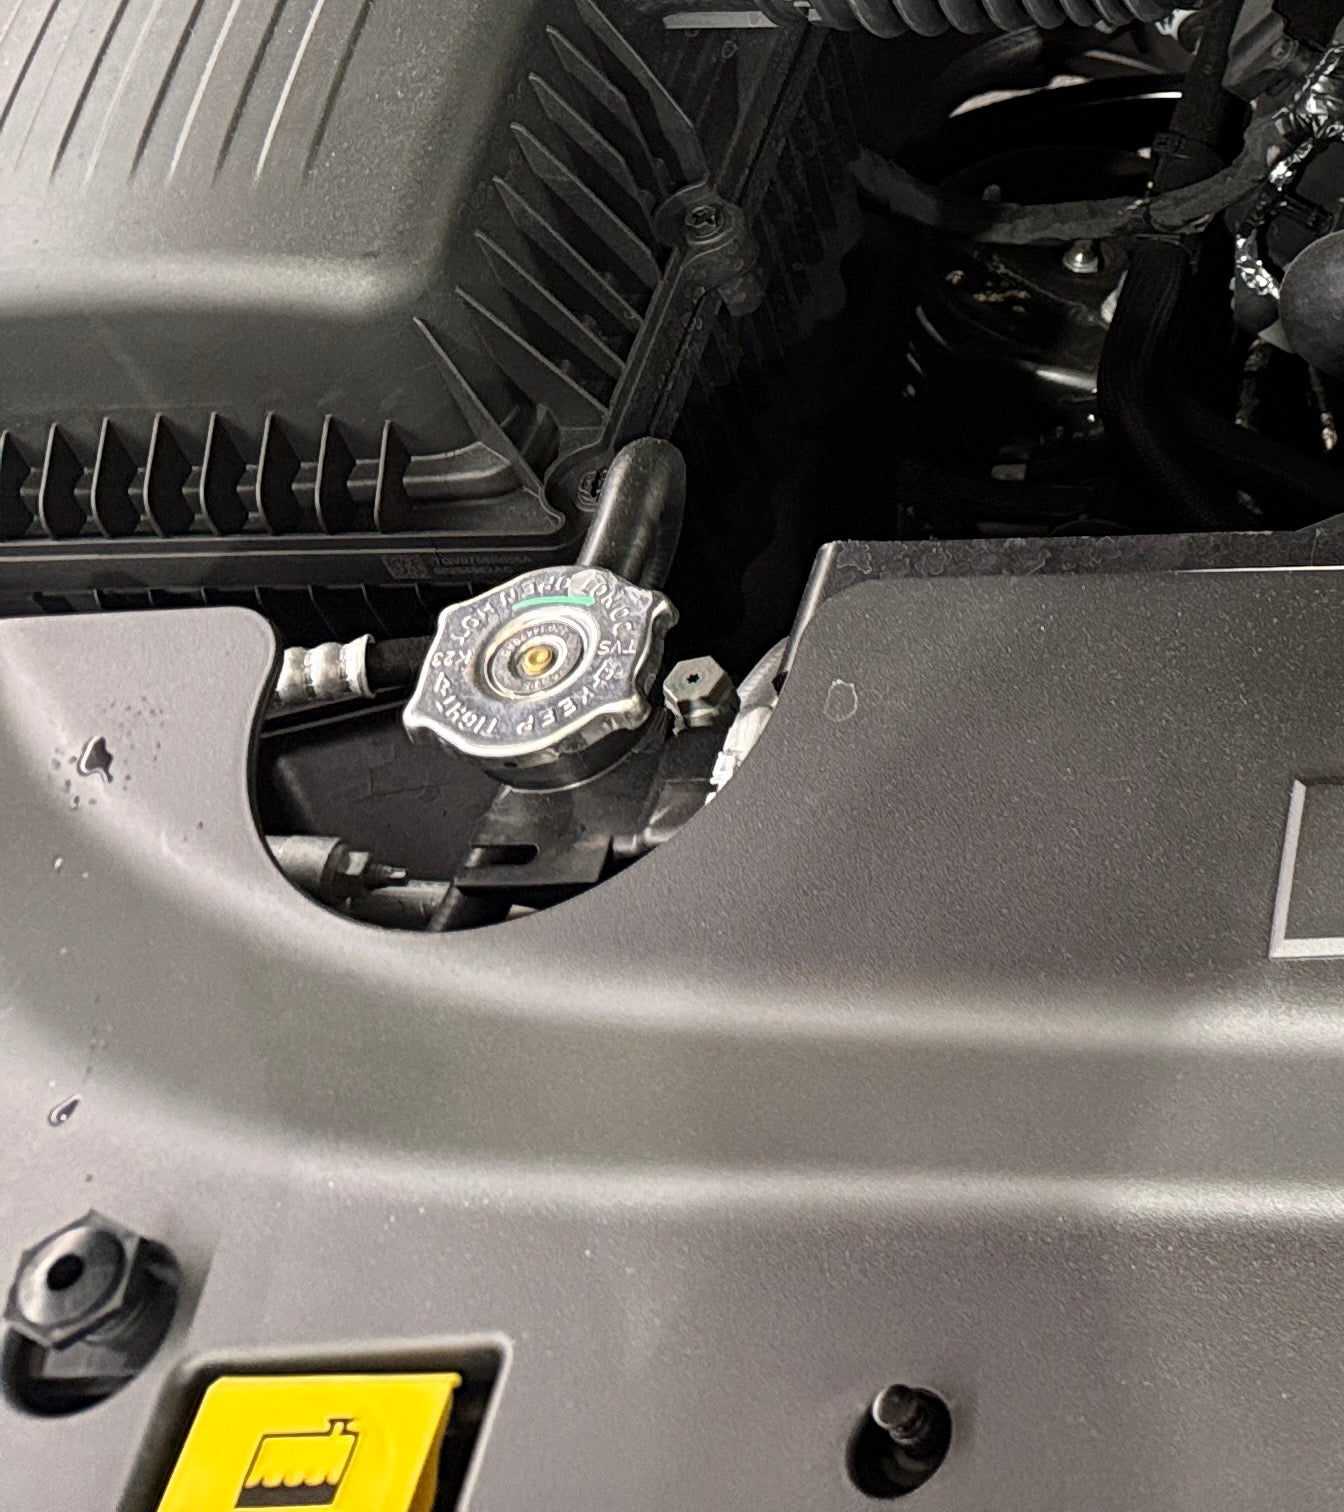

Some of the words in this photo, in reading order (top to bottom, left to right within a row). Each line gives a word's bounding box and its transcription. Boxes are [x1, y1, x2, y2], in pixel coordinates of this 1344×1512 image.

[499, 575, 572, 607] OPEN
[451, 601, 496, 647] HOT
[431, 648, 473, 668] K23
[597, 639, 637, 656] TVS
[516, 686, 595, 736] KEEP
